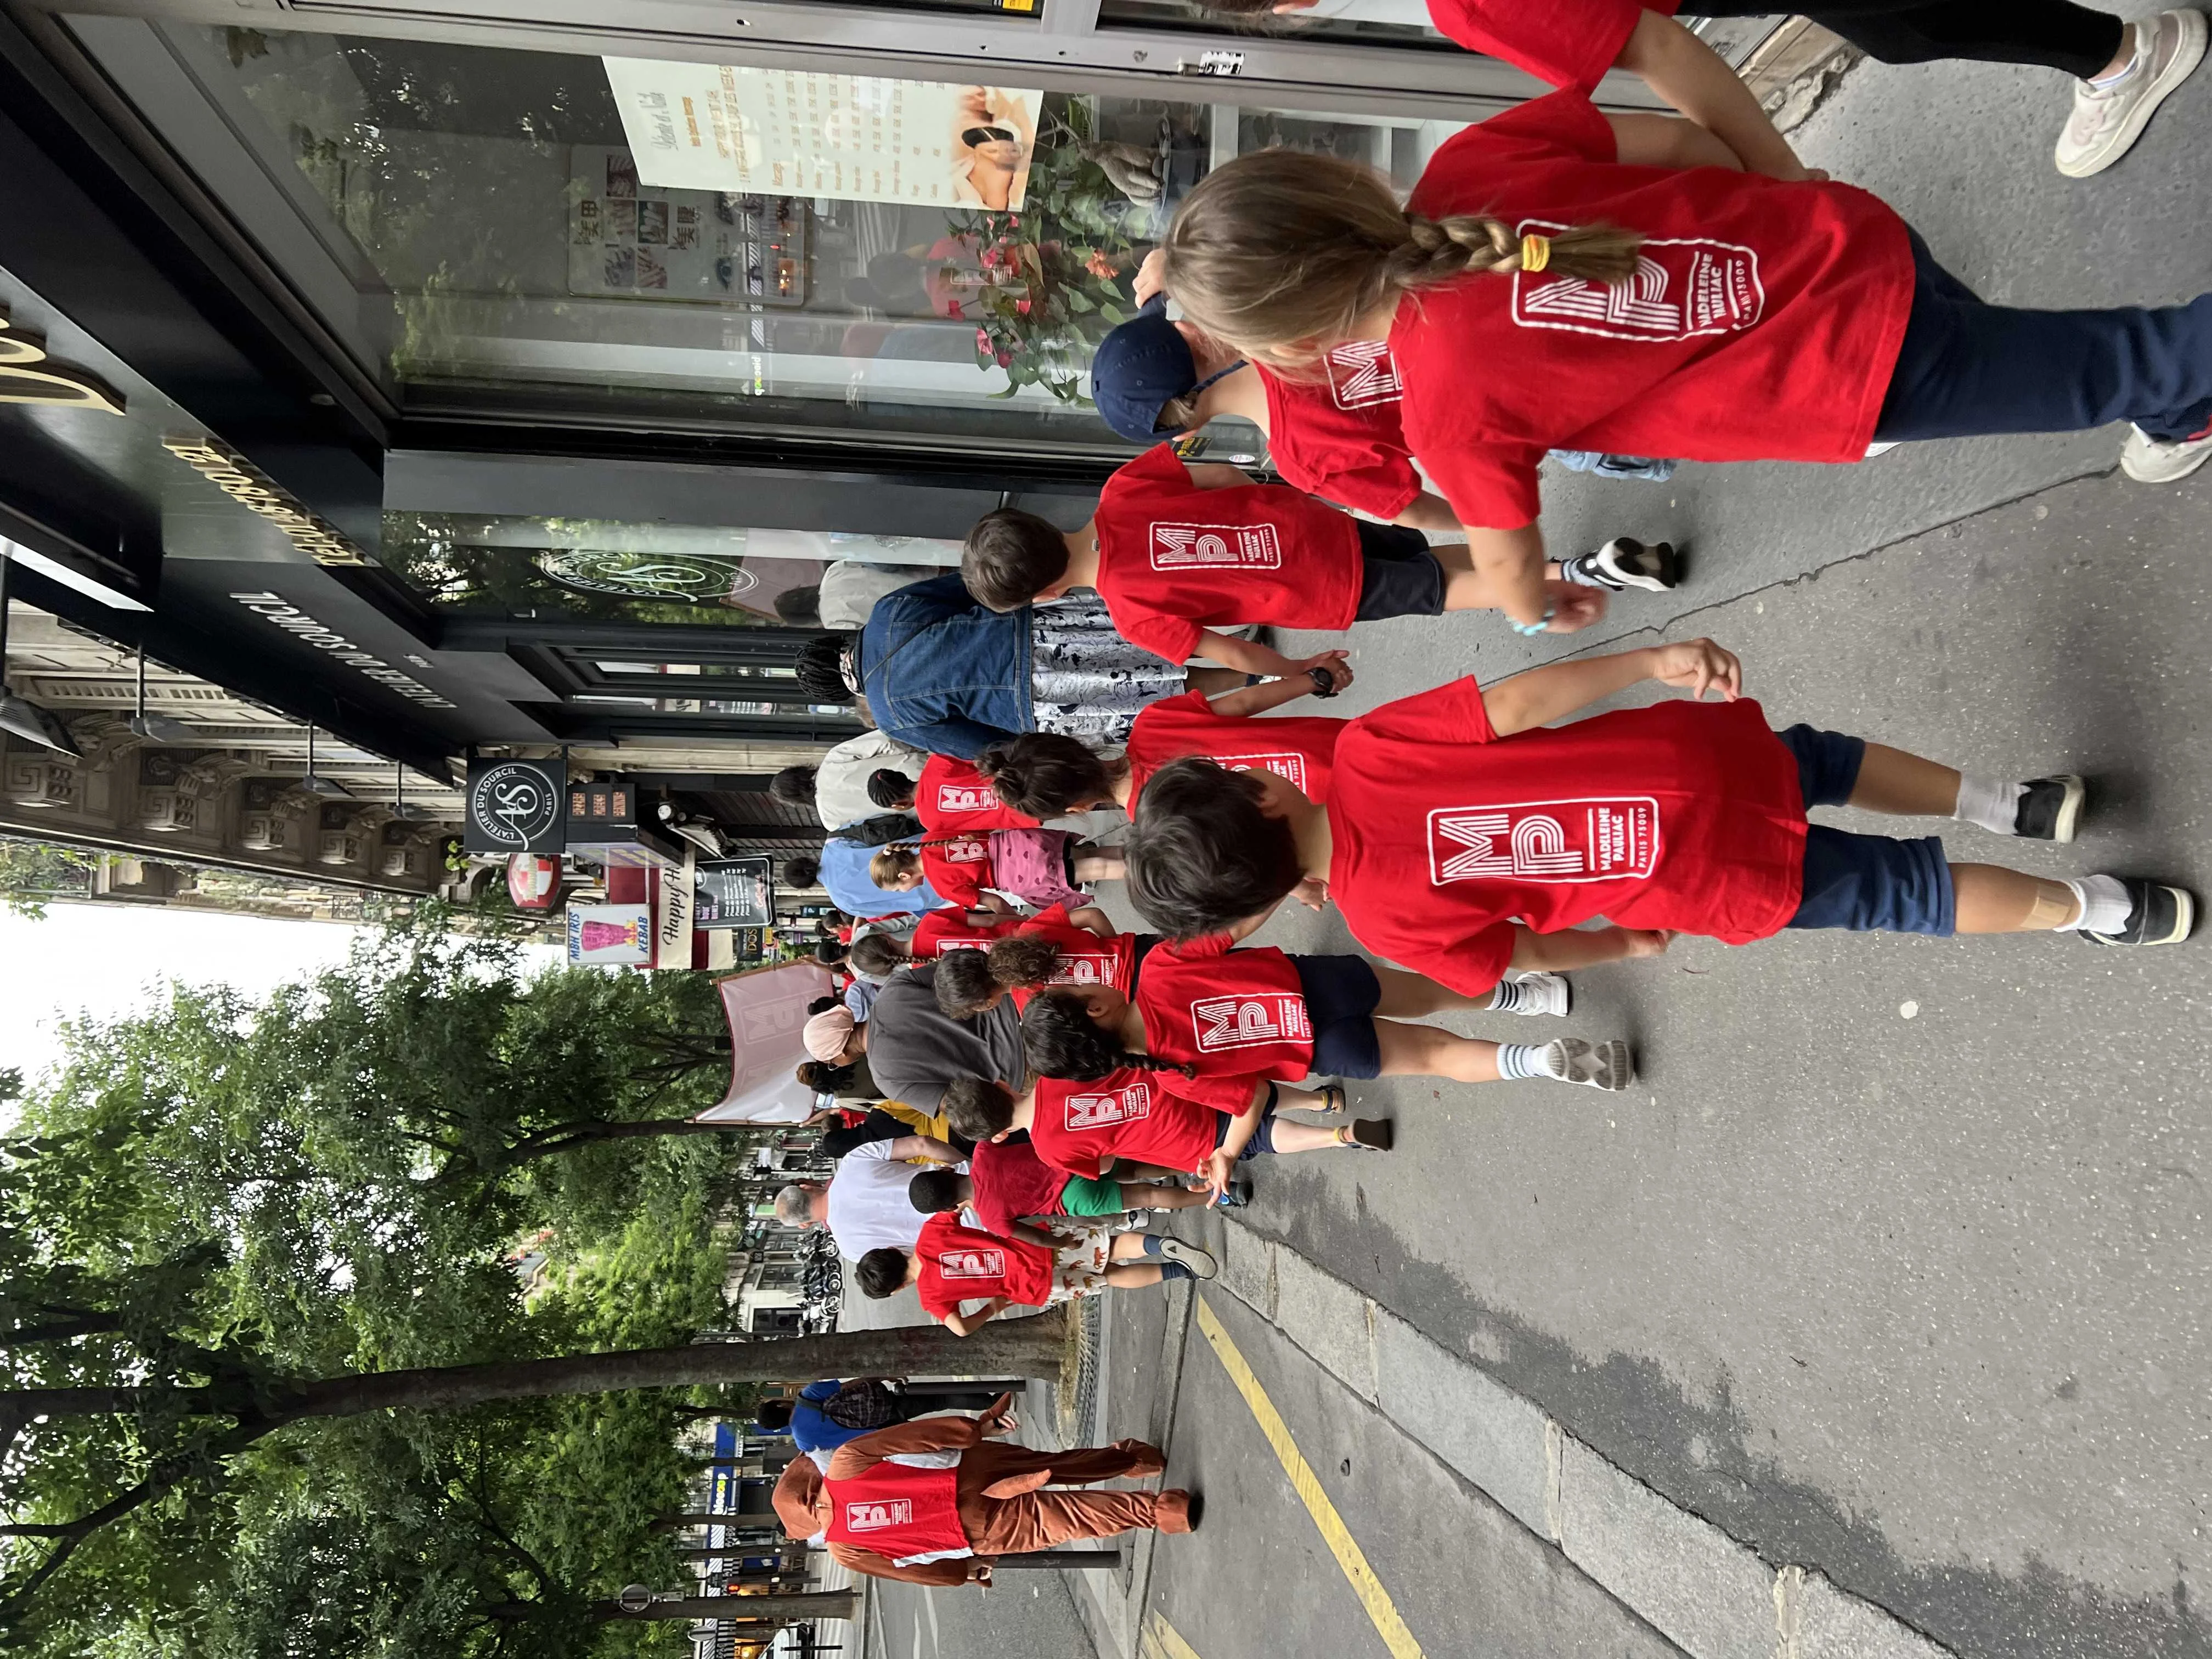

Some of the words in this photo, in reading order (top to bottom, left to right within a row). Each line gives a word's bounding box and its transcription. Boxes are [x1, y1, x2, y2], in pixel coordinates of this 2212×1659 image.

[1735, 259, 1749, 295] 75009
[229, 591, 357, 648] SOURCIL
[329, 651, 387, 666] DU
[360, 669, 458, 708] L'ATELIER
[479, 768, 516, 793] SOURCIL
[477, 794, 485, 808] DU
[573, 793, 585, 816] PIZZAS
[594, 794, 606, 816] GRECS
[613, 792, 625, 817] PANINIS
[478, 811, 514, 839] L'ATELIER
[1638, 808, 1647, 837] 75009
[1598, 808, 1611, 871] MADELEINE
[1612, 815, 1624, 861] PAULIAC
[1638, 840, 1648, 868] PARIS
[569, 912, 580, 933] IRIS
[662, 886, 688, 945] Happy
[569, 937, 580, 960] MBH
[638, 916, 648, 953] KEBAB
[1284, 999, 1295, 1036] MADELEINE
[1291, 1003, 1300, 1032] PAULIAC
[1304, 1022, 1312, 1037] PARIS
[712, 1473, 729, 1514] biocoop
